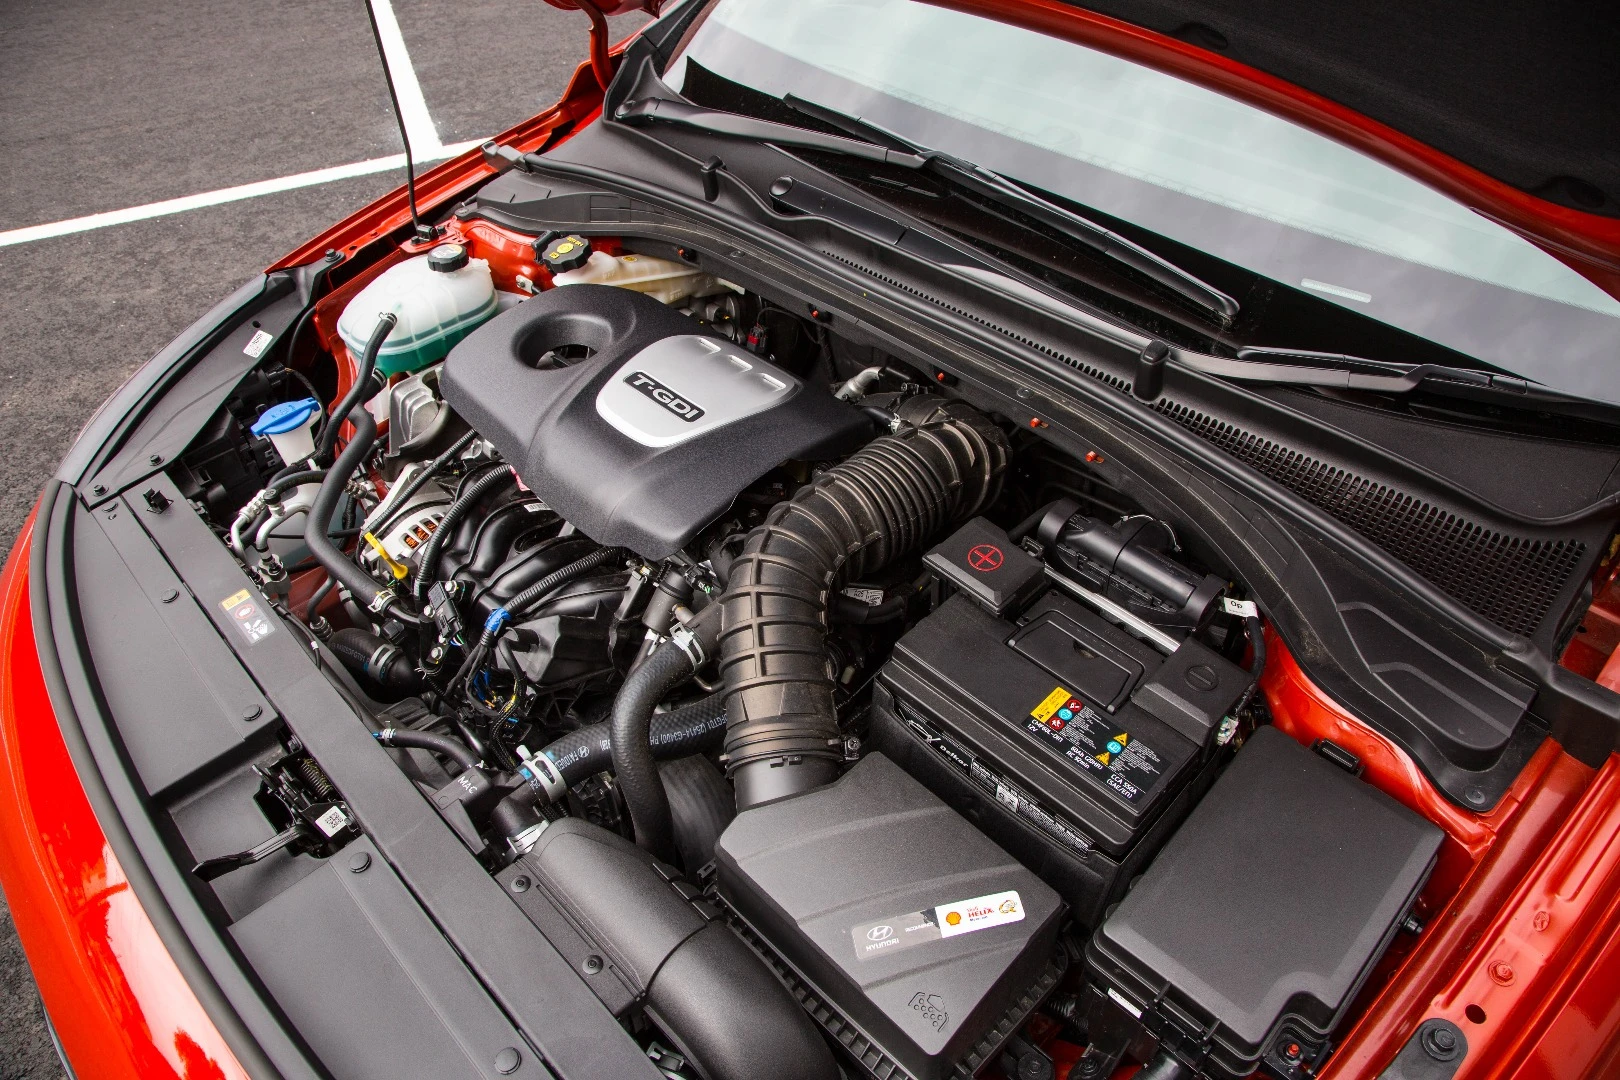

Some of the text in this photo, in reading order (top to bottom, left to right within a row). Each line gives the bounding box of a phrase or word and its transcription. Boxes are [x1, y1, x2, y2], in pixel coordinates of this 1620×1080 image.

[457, 775, 478, 794] MAC
[1110, 773, 1138, 795] CCA 550A
[865, 937, 900, 952] HYUNDAI
